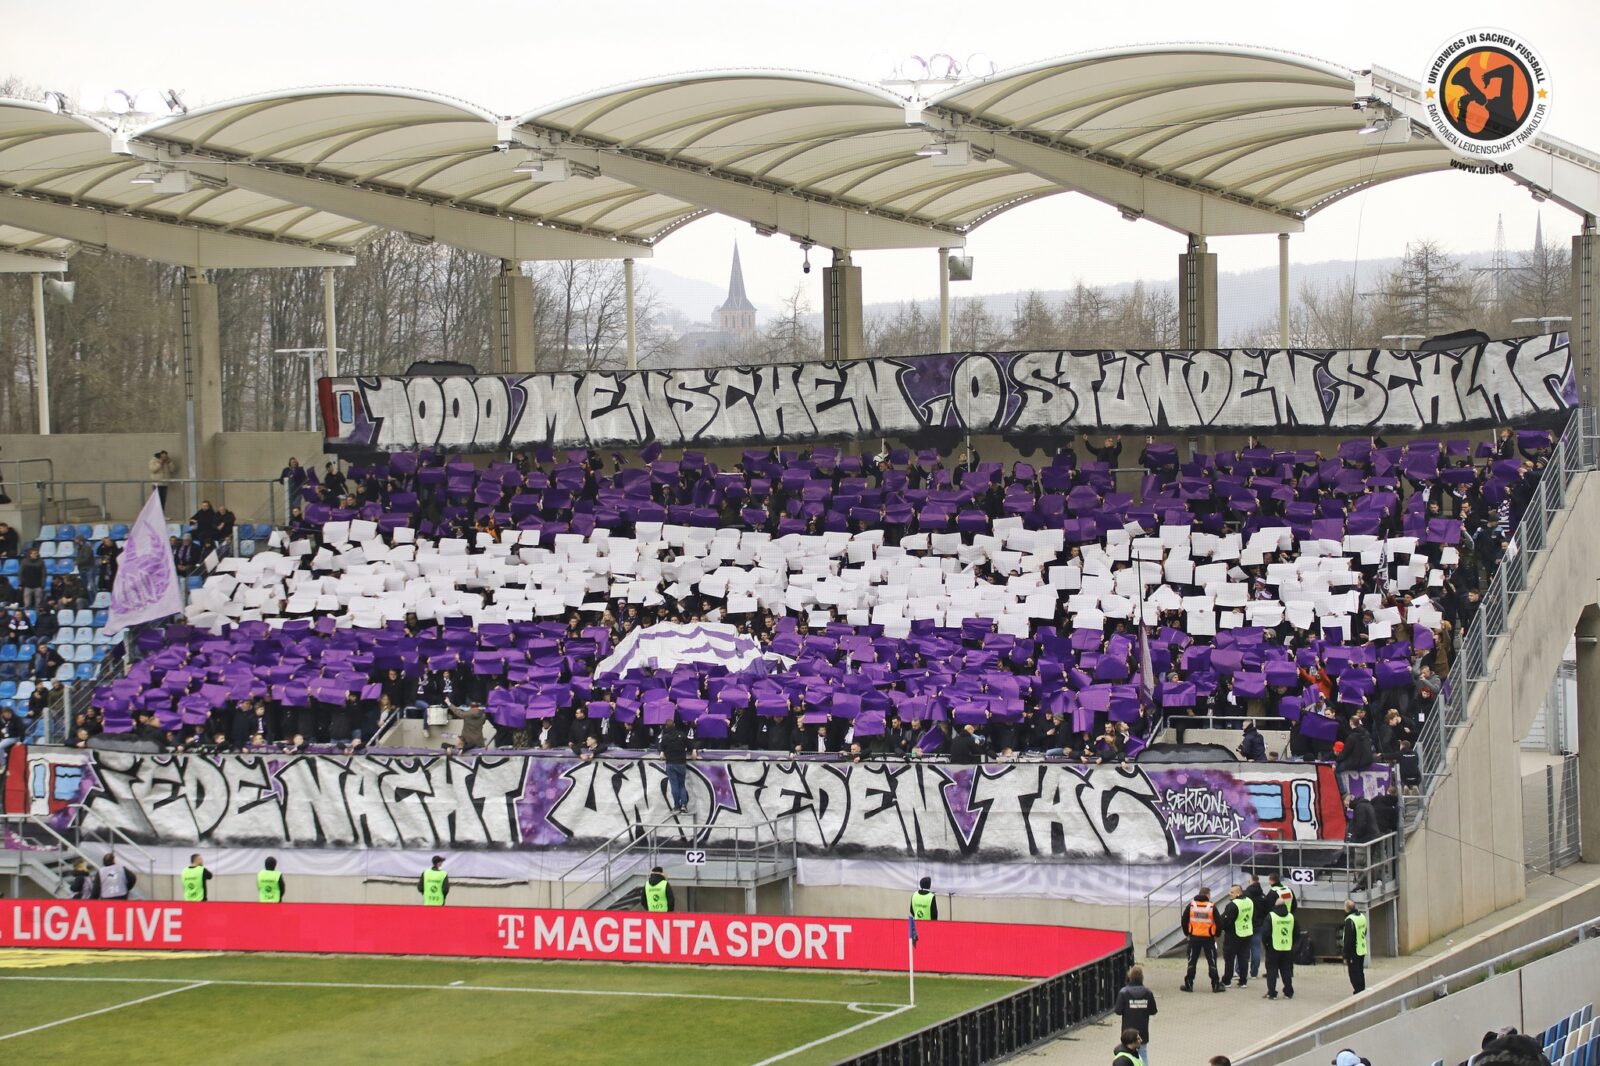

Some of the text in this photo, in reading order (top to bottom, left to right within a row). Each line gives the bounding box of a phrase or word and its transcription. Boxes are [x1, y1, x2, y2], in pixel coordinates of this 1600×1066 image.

[358, 375, 512, 447] 1000
[1006, 349, 1328, 430] STUNDEN
[79, 753, 1178, 857] JEDE NACHT UND JEDEN TAG
[686, 851, 705, 864] C2
[1292, 870, 1314, 883] C3
[13, 905, 183, 942] LIGA LIVE
[534, 915, 720, 957] MAGENTA
[726, 920, 853, 961] SPORT
